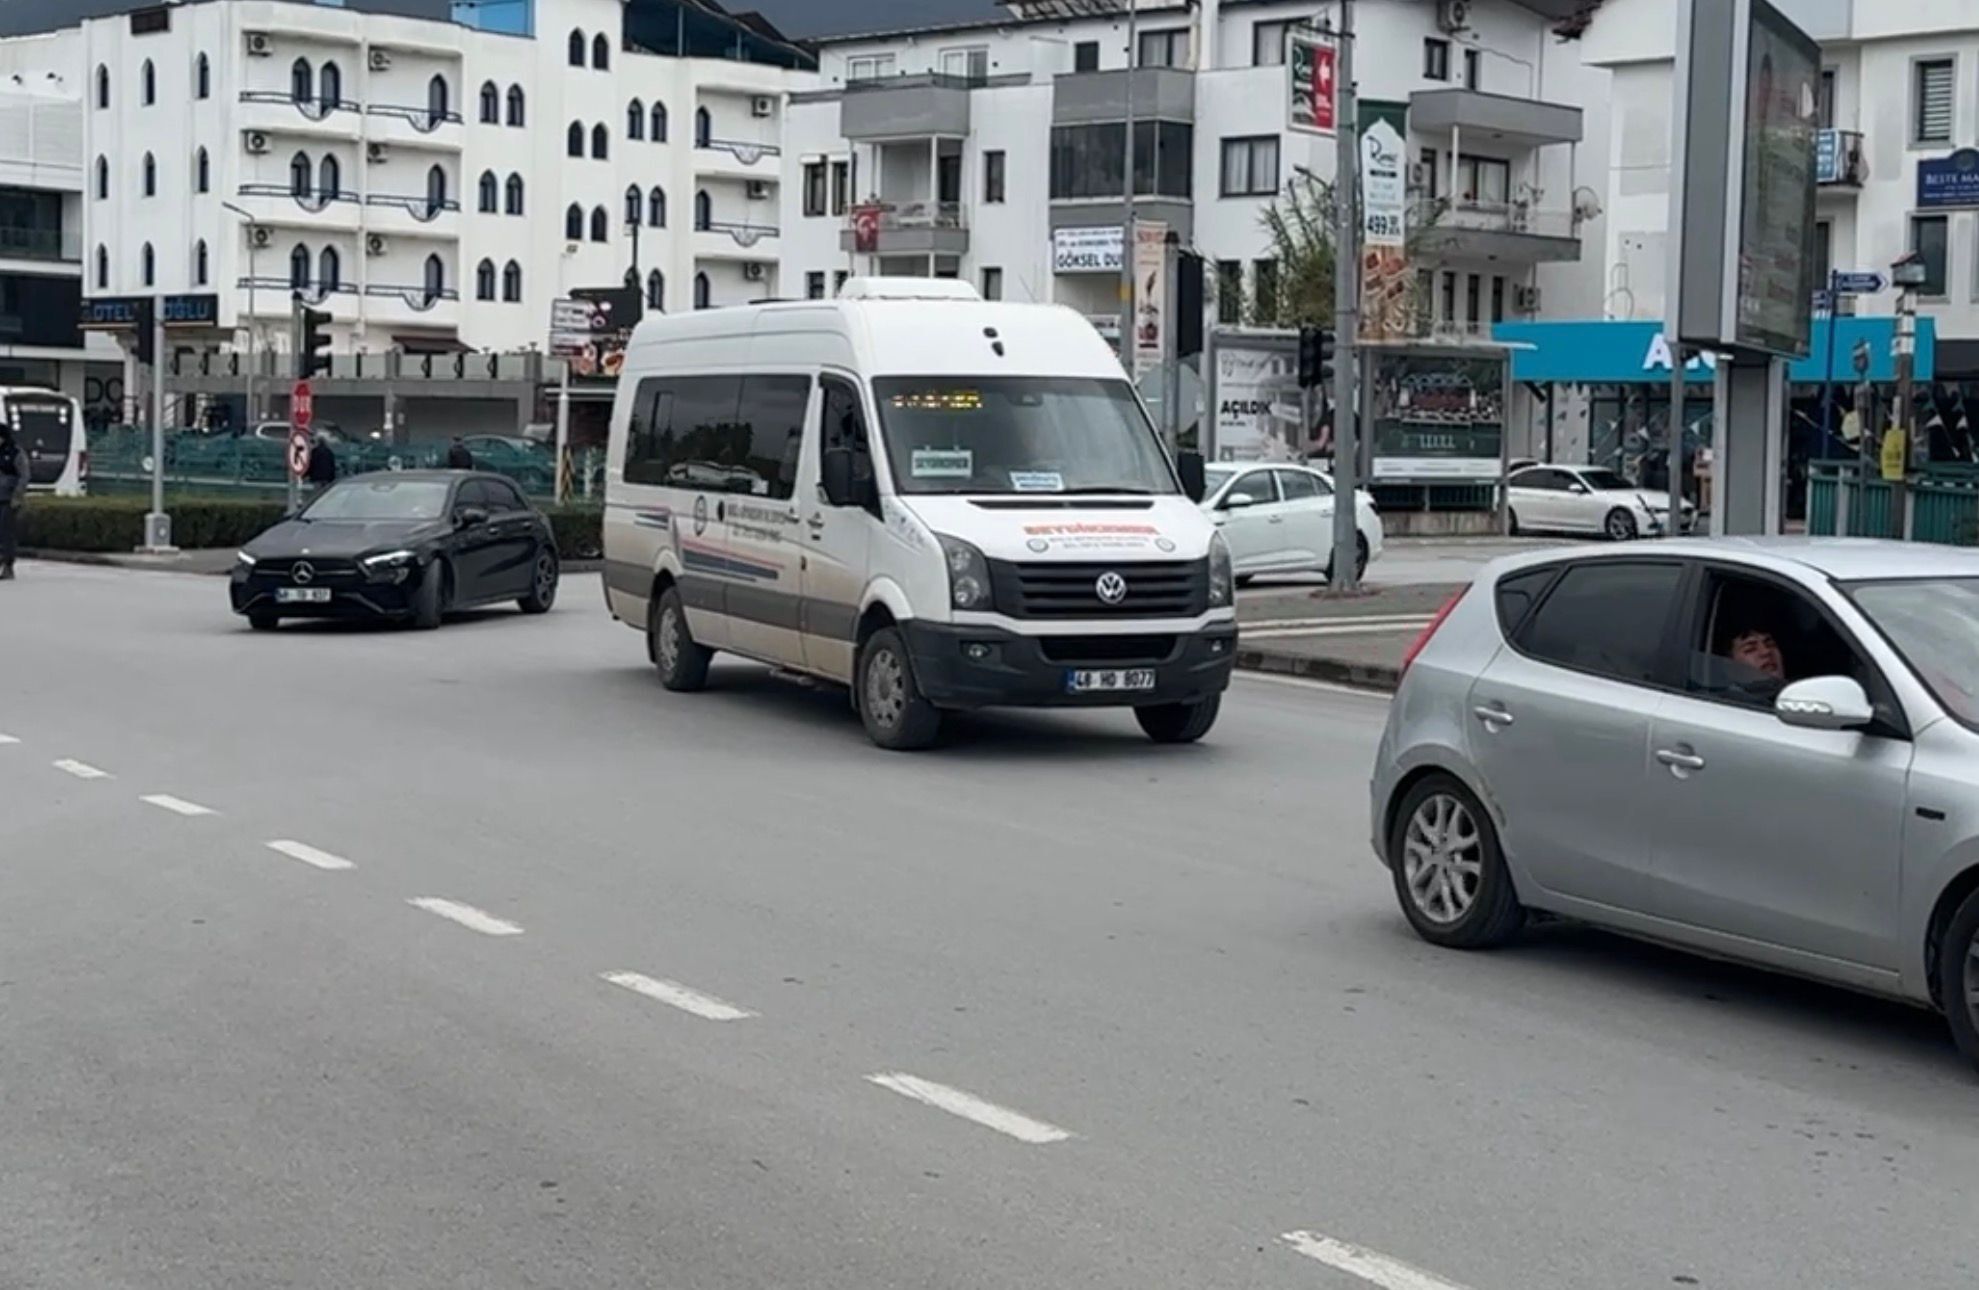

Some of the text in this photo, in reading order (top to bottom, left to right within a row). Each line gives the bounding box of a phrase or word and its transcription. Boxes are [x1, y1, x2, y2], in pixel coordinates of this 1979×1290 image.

[1058, 250, 1100, 268] GÖKSEL
[1220, 400, 1272, 419] AÇILDIK
[1075, 671, 1091, 688] 48
